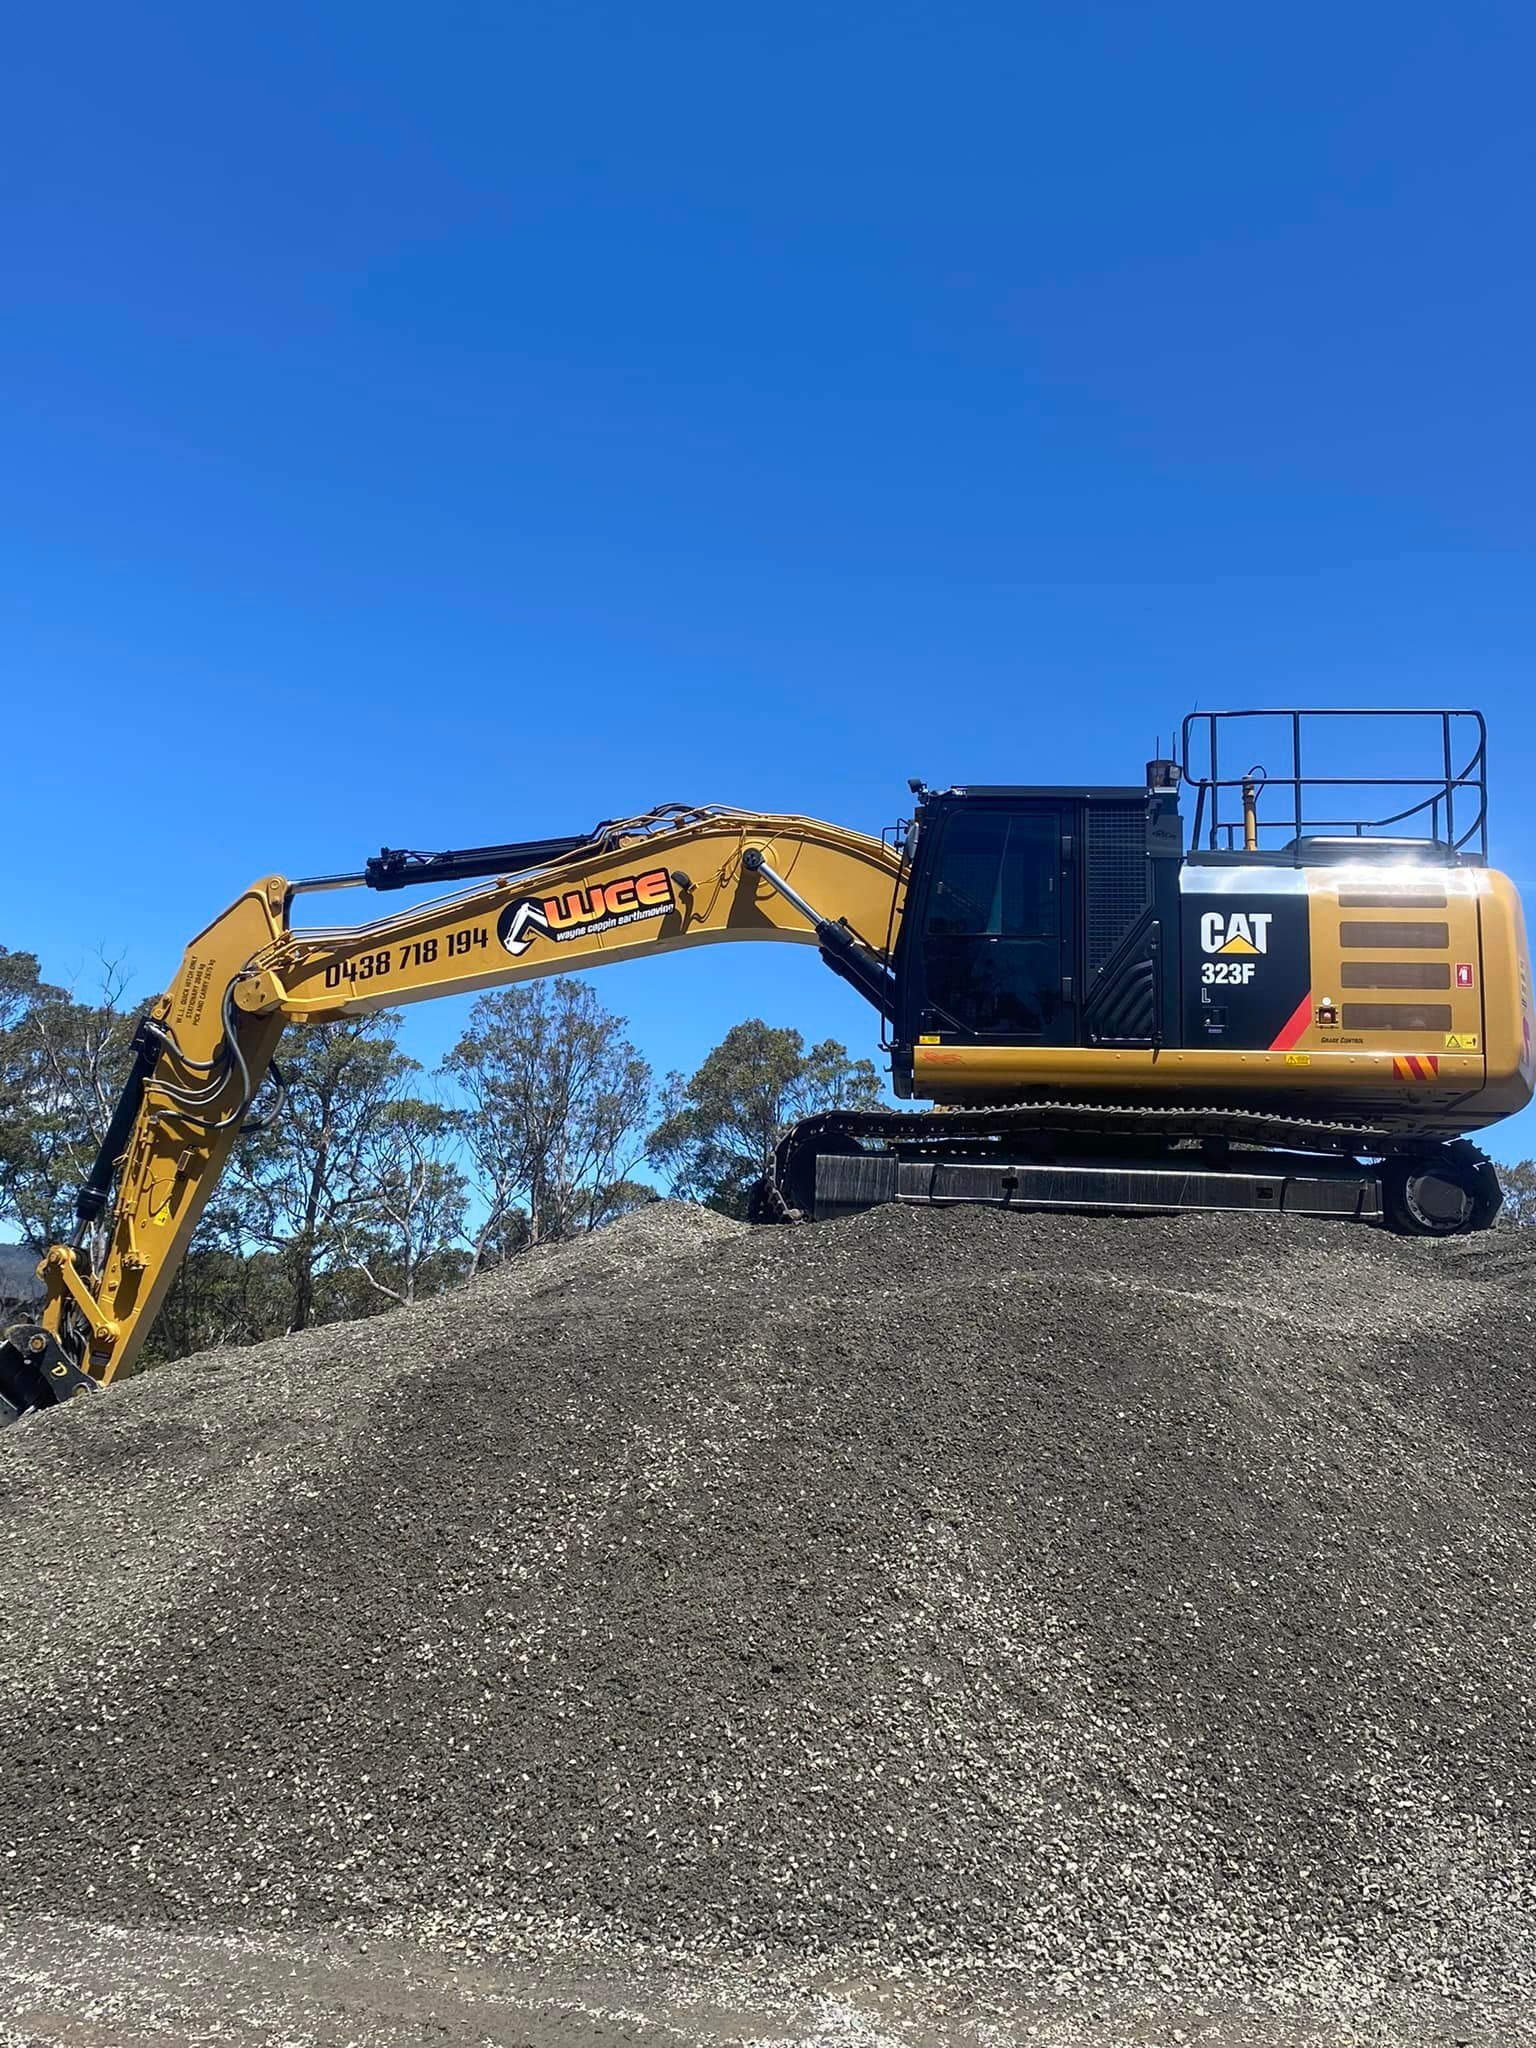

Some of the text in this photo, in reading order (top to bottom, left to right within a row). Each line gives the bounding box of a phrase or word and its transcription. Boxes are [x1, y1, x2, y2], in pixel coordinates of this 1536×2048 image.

[556, 926, 586, 941] wayne
[617, 904, 674, 925] earthmoving
[1200, 912, 1273, 954] CAT
[325, 927, 488, 988] 0438 718 194
[1201, 963, 1255, 984] 323F
[1201, 987, 1211, 1003] L
